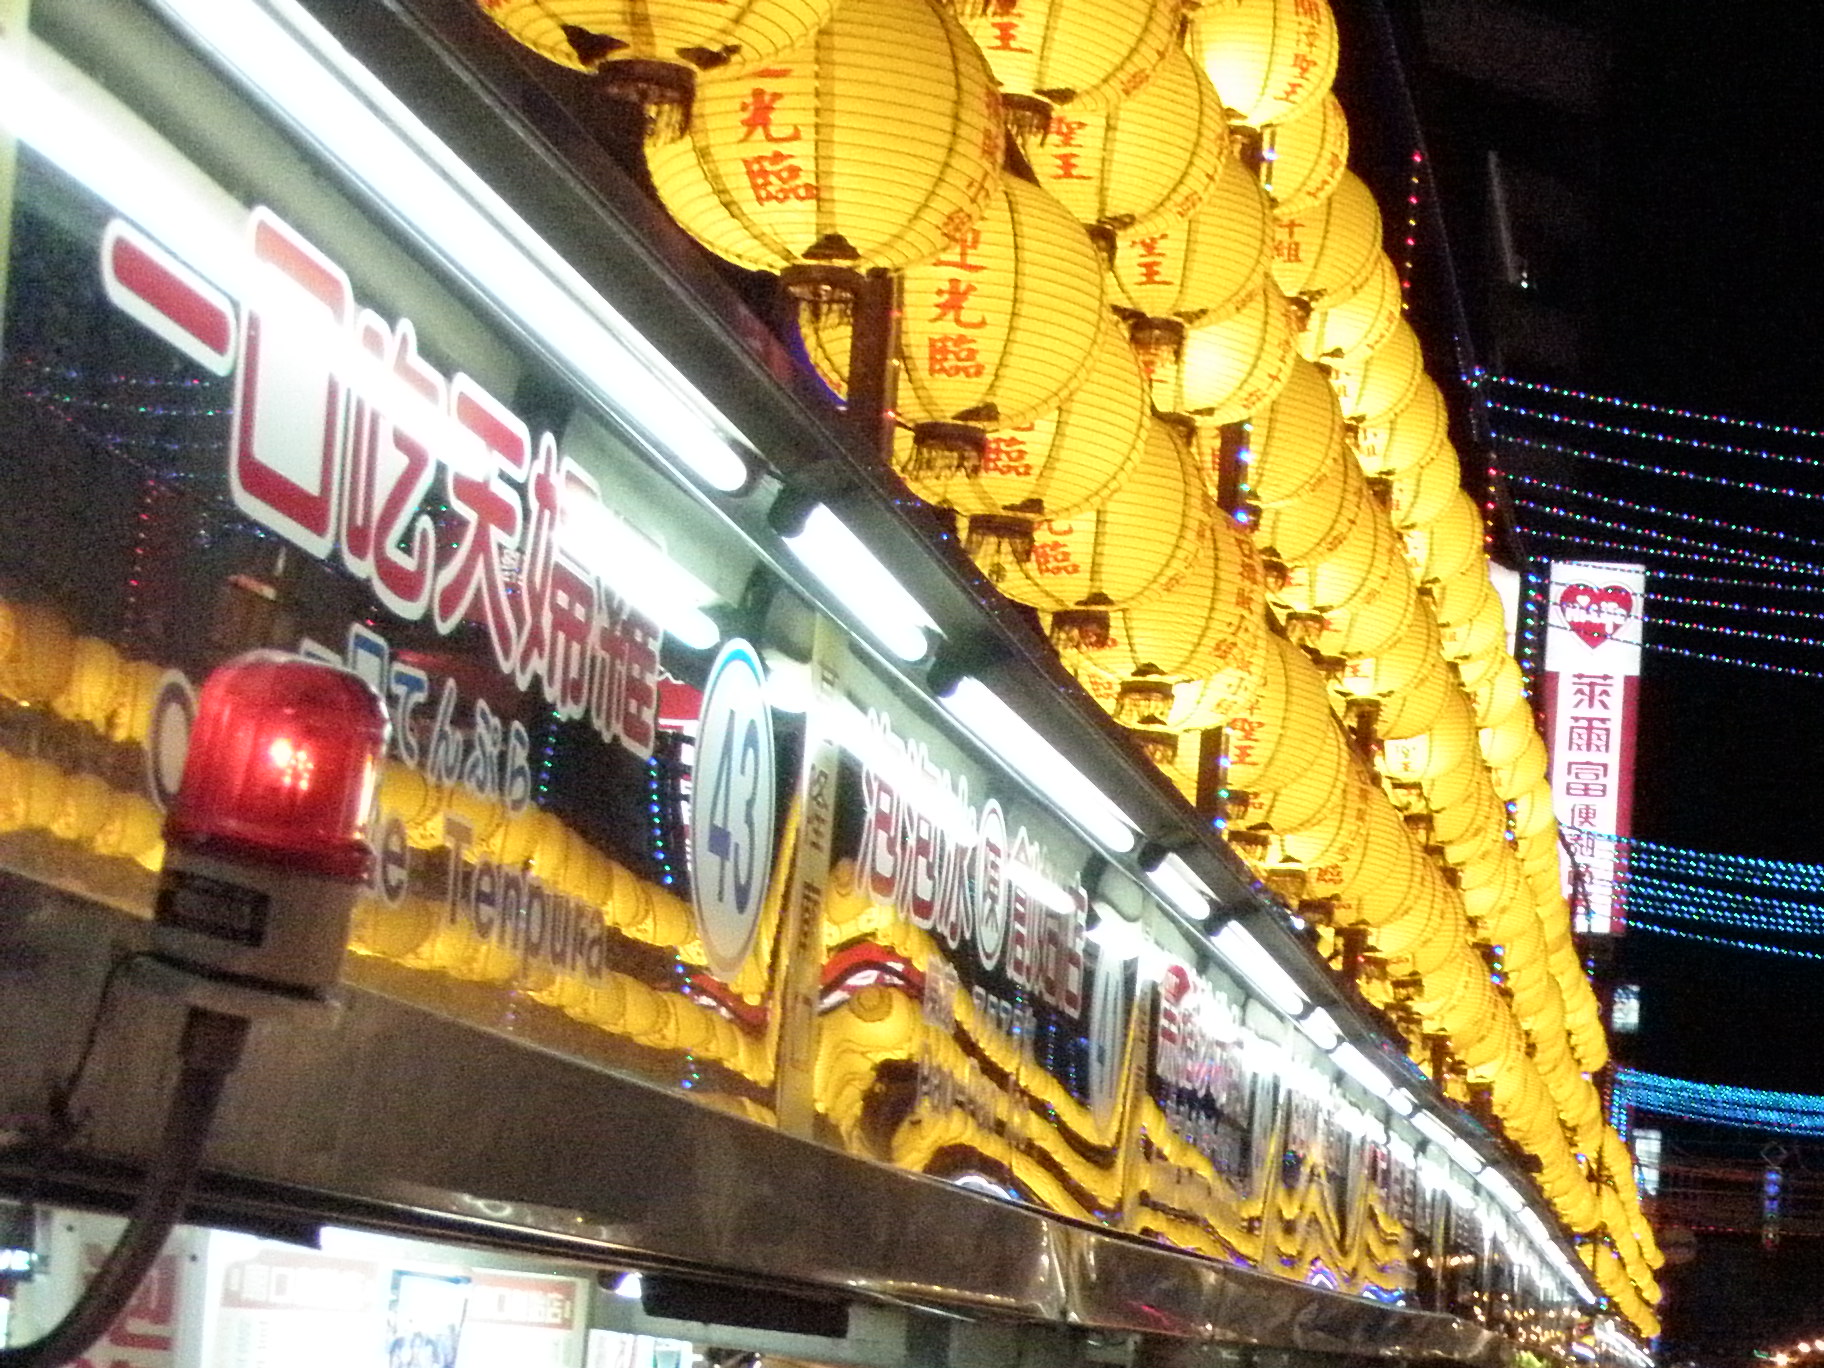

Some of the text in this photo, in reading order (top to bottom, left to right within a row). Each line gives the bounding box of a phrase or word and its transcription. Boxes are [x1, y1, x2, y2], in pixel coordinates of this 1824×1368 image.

[738, 67, 819, 207] 光臨
[1564, 673, 1615, 798] 萊爾富
[706, 706, 761, 917] 43
